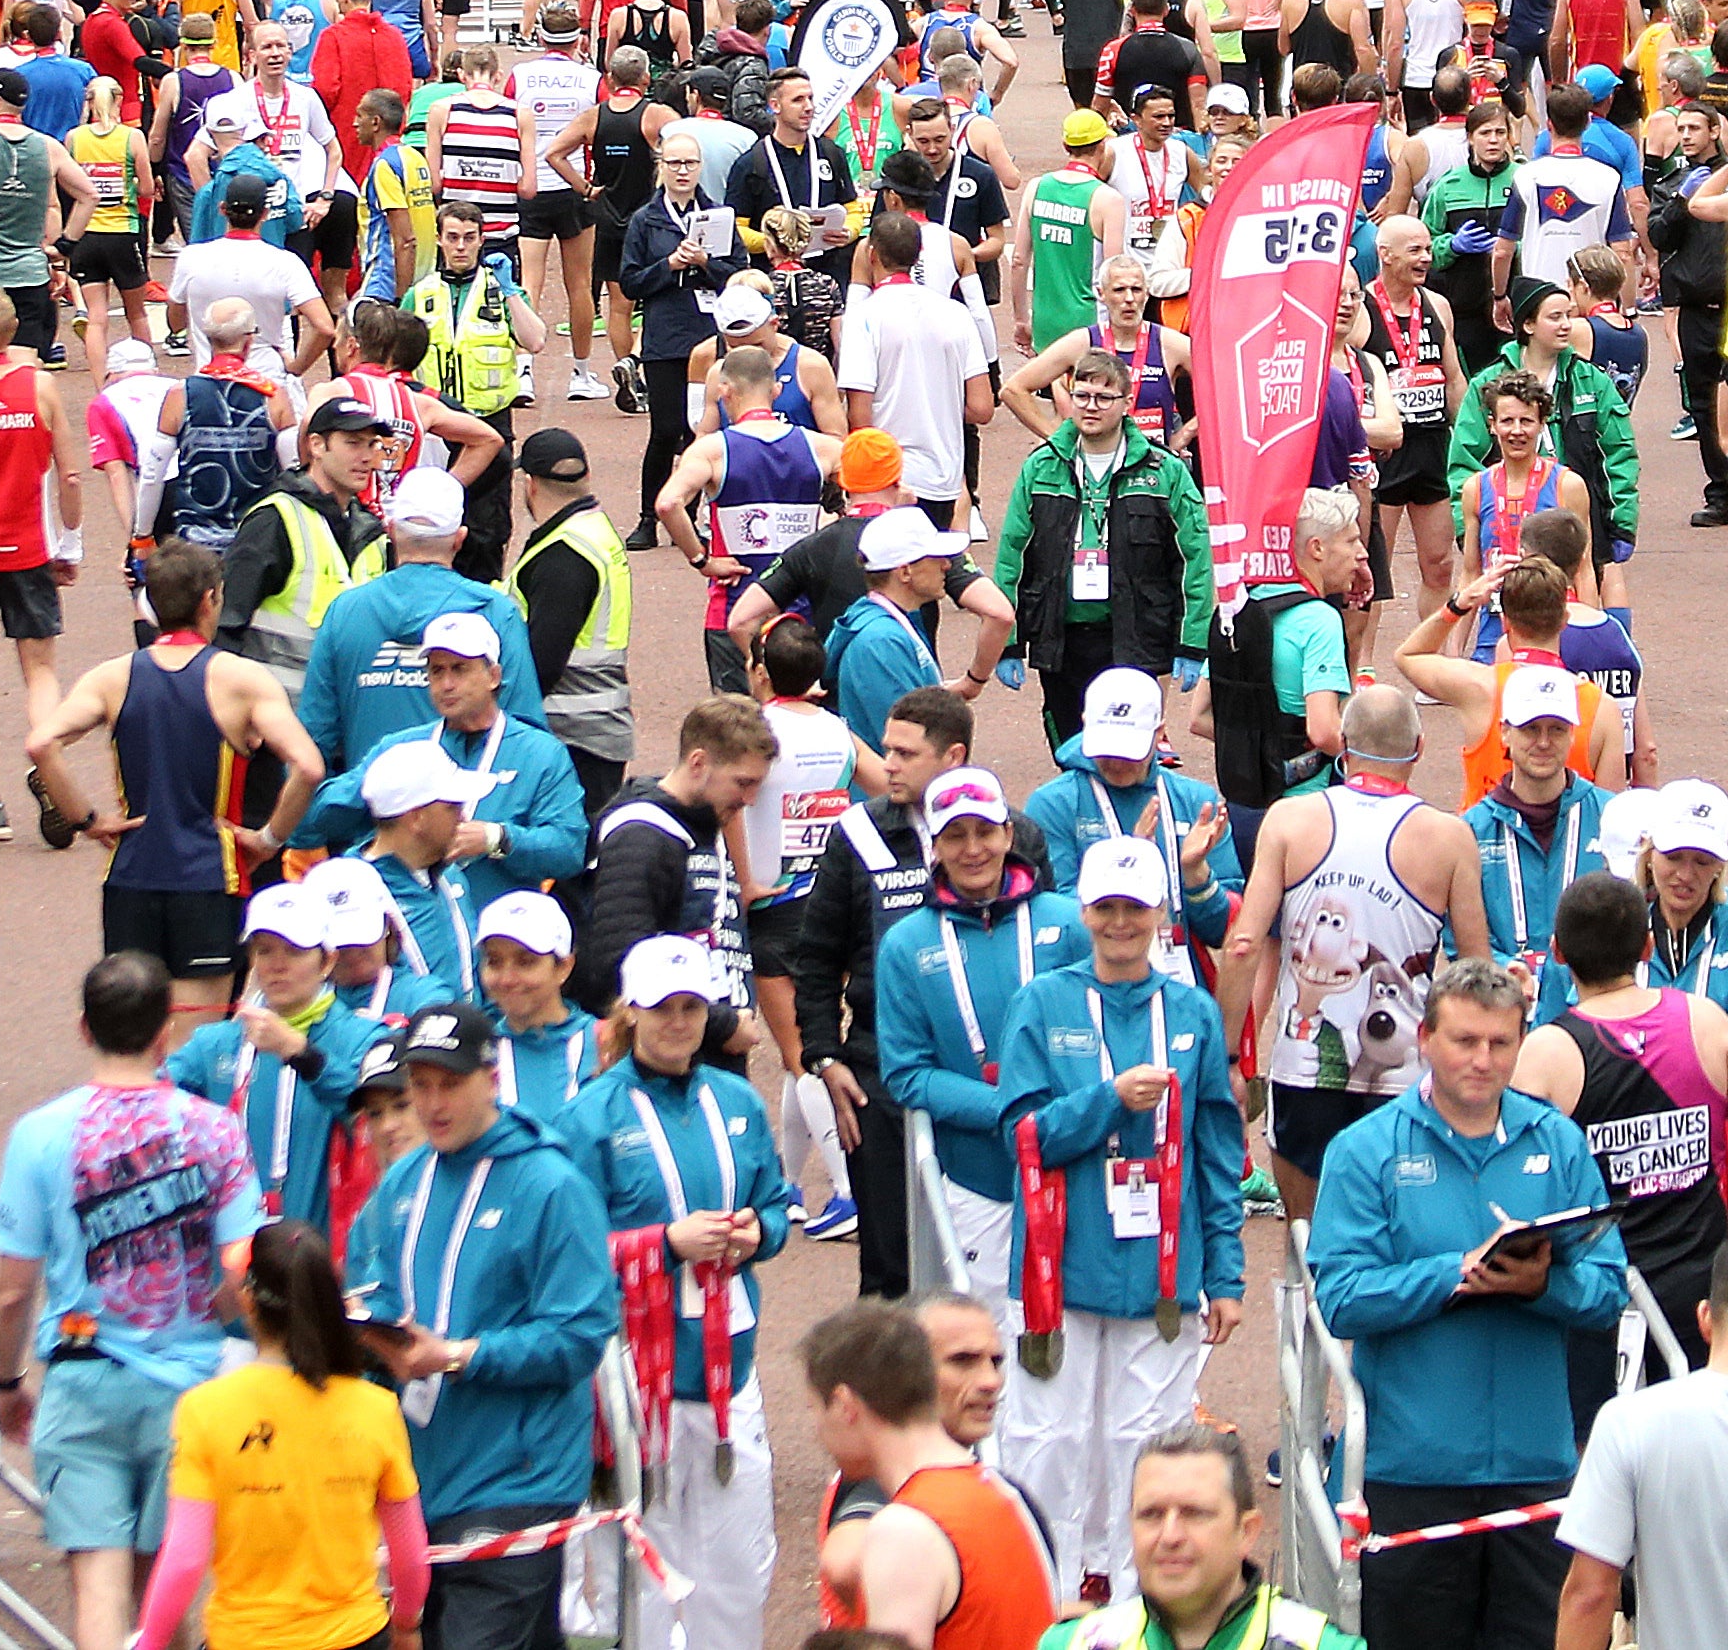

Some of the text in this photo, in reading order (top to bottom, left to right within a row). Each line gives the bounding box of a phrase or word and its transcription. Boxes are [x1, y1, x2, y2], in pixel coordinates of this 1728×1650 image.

[832, 3, 880, 31] GUINNESS
[824, 29, 846, 64] WORLD
[526, 74, 586, 90] BRAZIL
[459, 164, 501, 179] Pacers
[95, 180, 112, 195] 35
[1032, 199, 1087, 227] WARREN
[1040, 223, 1073, 246] PTFA
[1135, 222, 1153, 236] 48
[775, 524, 811, 534] ESEARC
[357, 670, 393, 689] new
[801, 824, 828, 847] 47
[873, 869, 929, 892] VIRGIN
[1314, 871, 1345, 891] KEEP
[1348, 874, 1366, 890] UP
[882, 891, 925, 910] LONDO
[1590, 1109, 1707, 1153] YOUNG LIVES
[1637, 1139, 1707, 1174] CANCER
